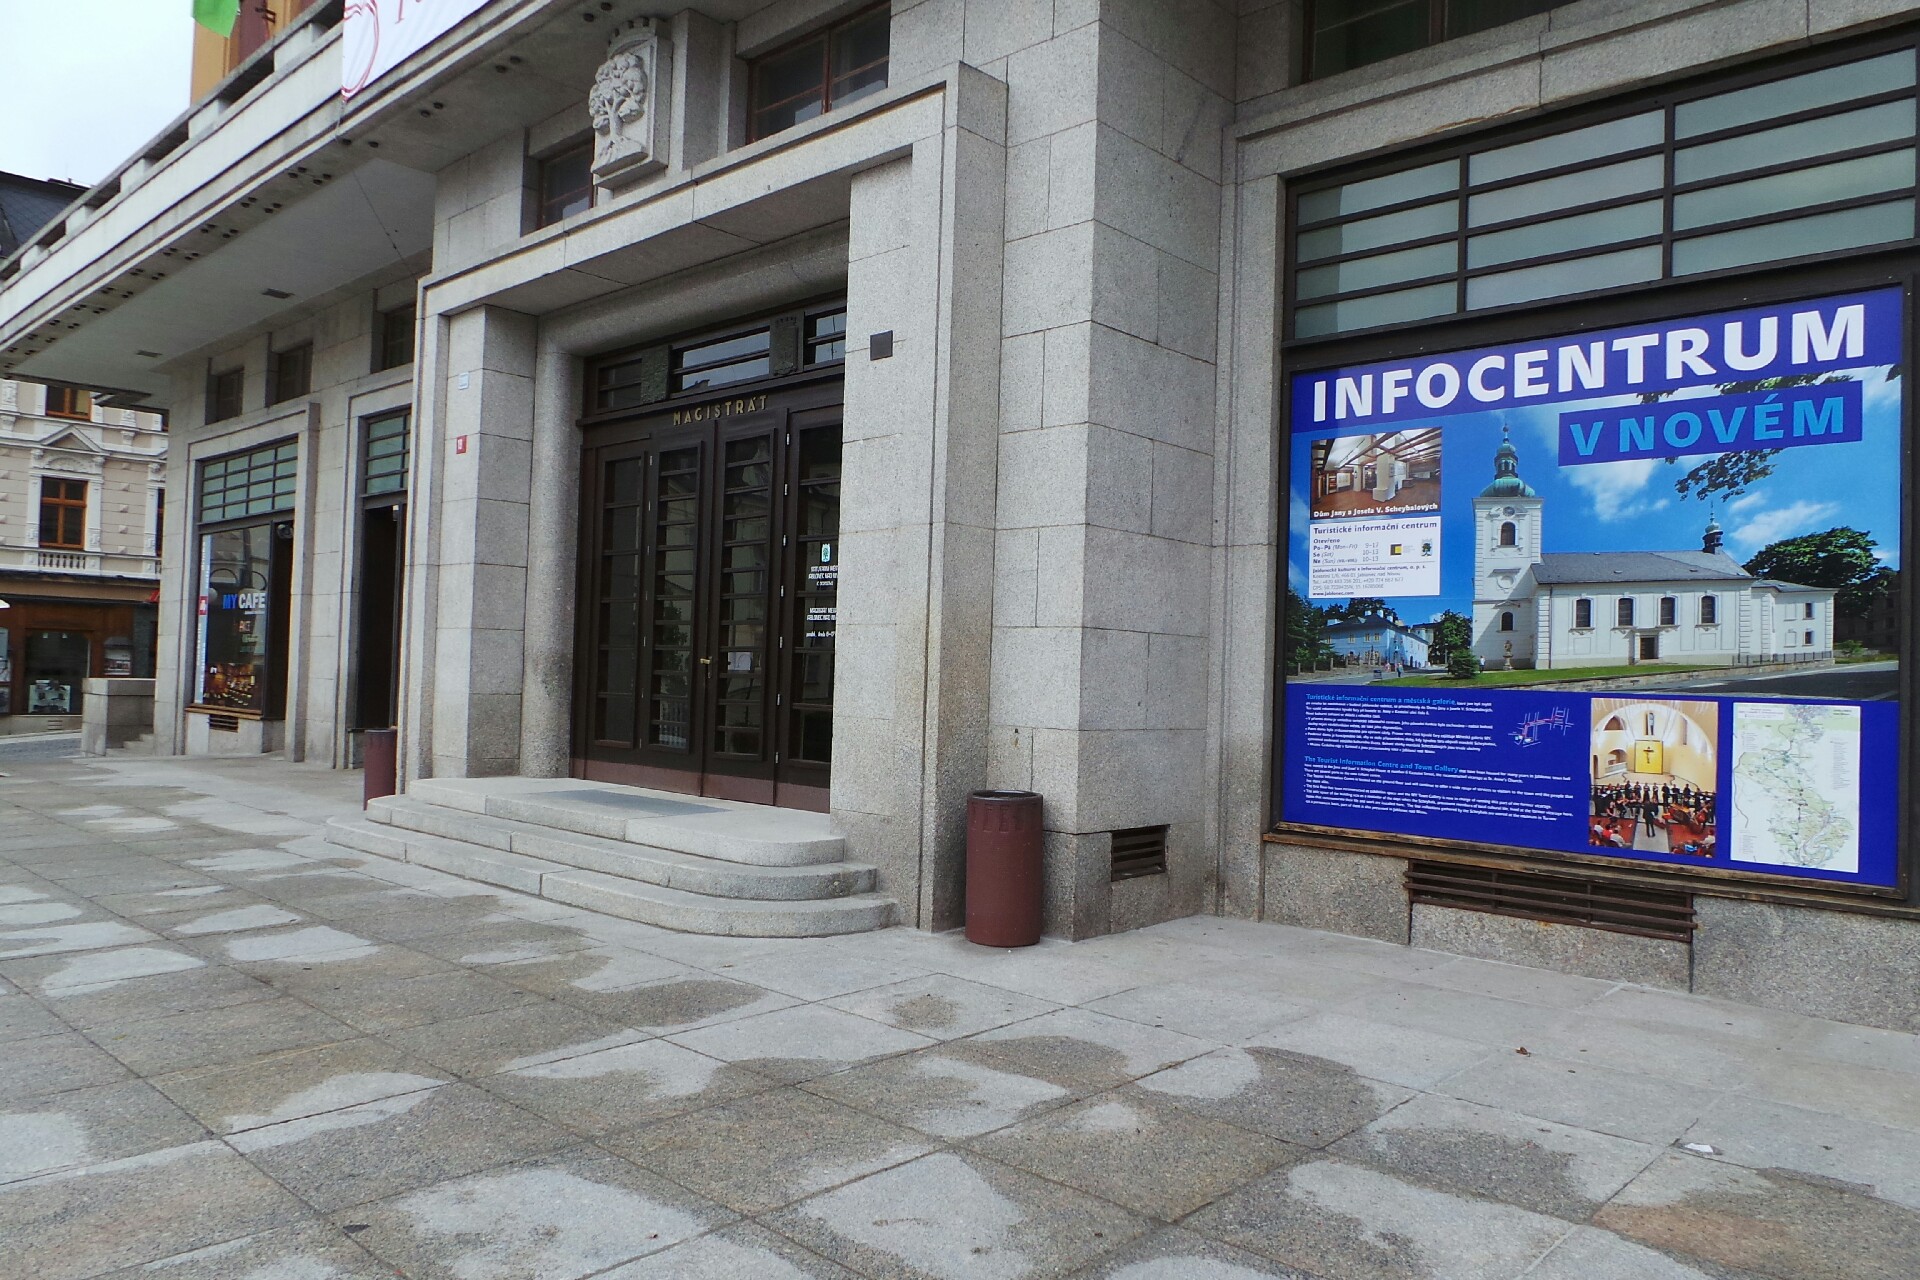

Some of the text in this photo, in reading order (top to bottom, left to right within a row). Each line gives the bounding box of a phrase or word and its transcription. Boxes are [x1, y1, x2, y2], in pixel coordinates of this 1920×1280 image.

[1313, 304, 1865, 422] INFOCENTRUM
[673, 394, 767, 426] MAGISTRÁT
[1569, 395, 1844, 457] V NOVÉM
[1330, 509, 1346, 518] Jany
[1353, 507, 1375, 516] Josefa
[1385, 503, 1438, 513] Scheybalových
[1313, 521, 1438, 535] Turistické informační centrum
[1313, 537, 1341, 545] Otevřeno
[222, 594, 238, 609] MY
[238, 592, 266, 609] CAFE
[1306, 693, 1335, 701] Turistické
[1336, 694, 1369, 702] informační
[1404, 696, 1431, 704] městská
[1432, 698, 1457, 706] galerie,
[1304, 755, 1316, 763] The
[1317, 756, 1338, 764] Tourist
[1339, 757, 1376, 767] Information
[1377, 760, 1399, 769] Centre
[1414, 763, 1432, 771] Town
[1434, 764, 1459, 774] Gallery
